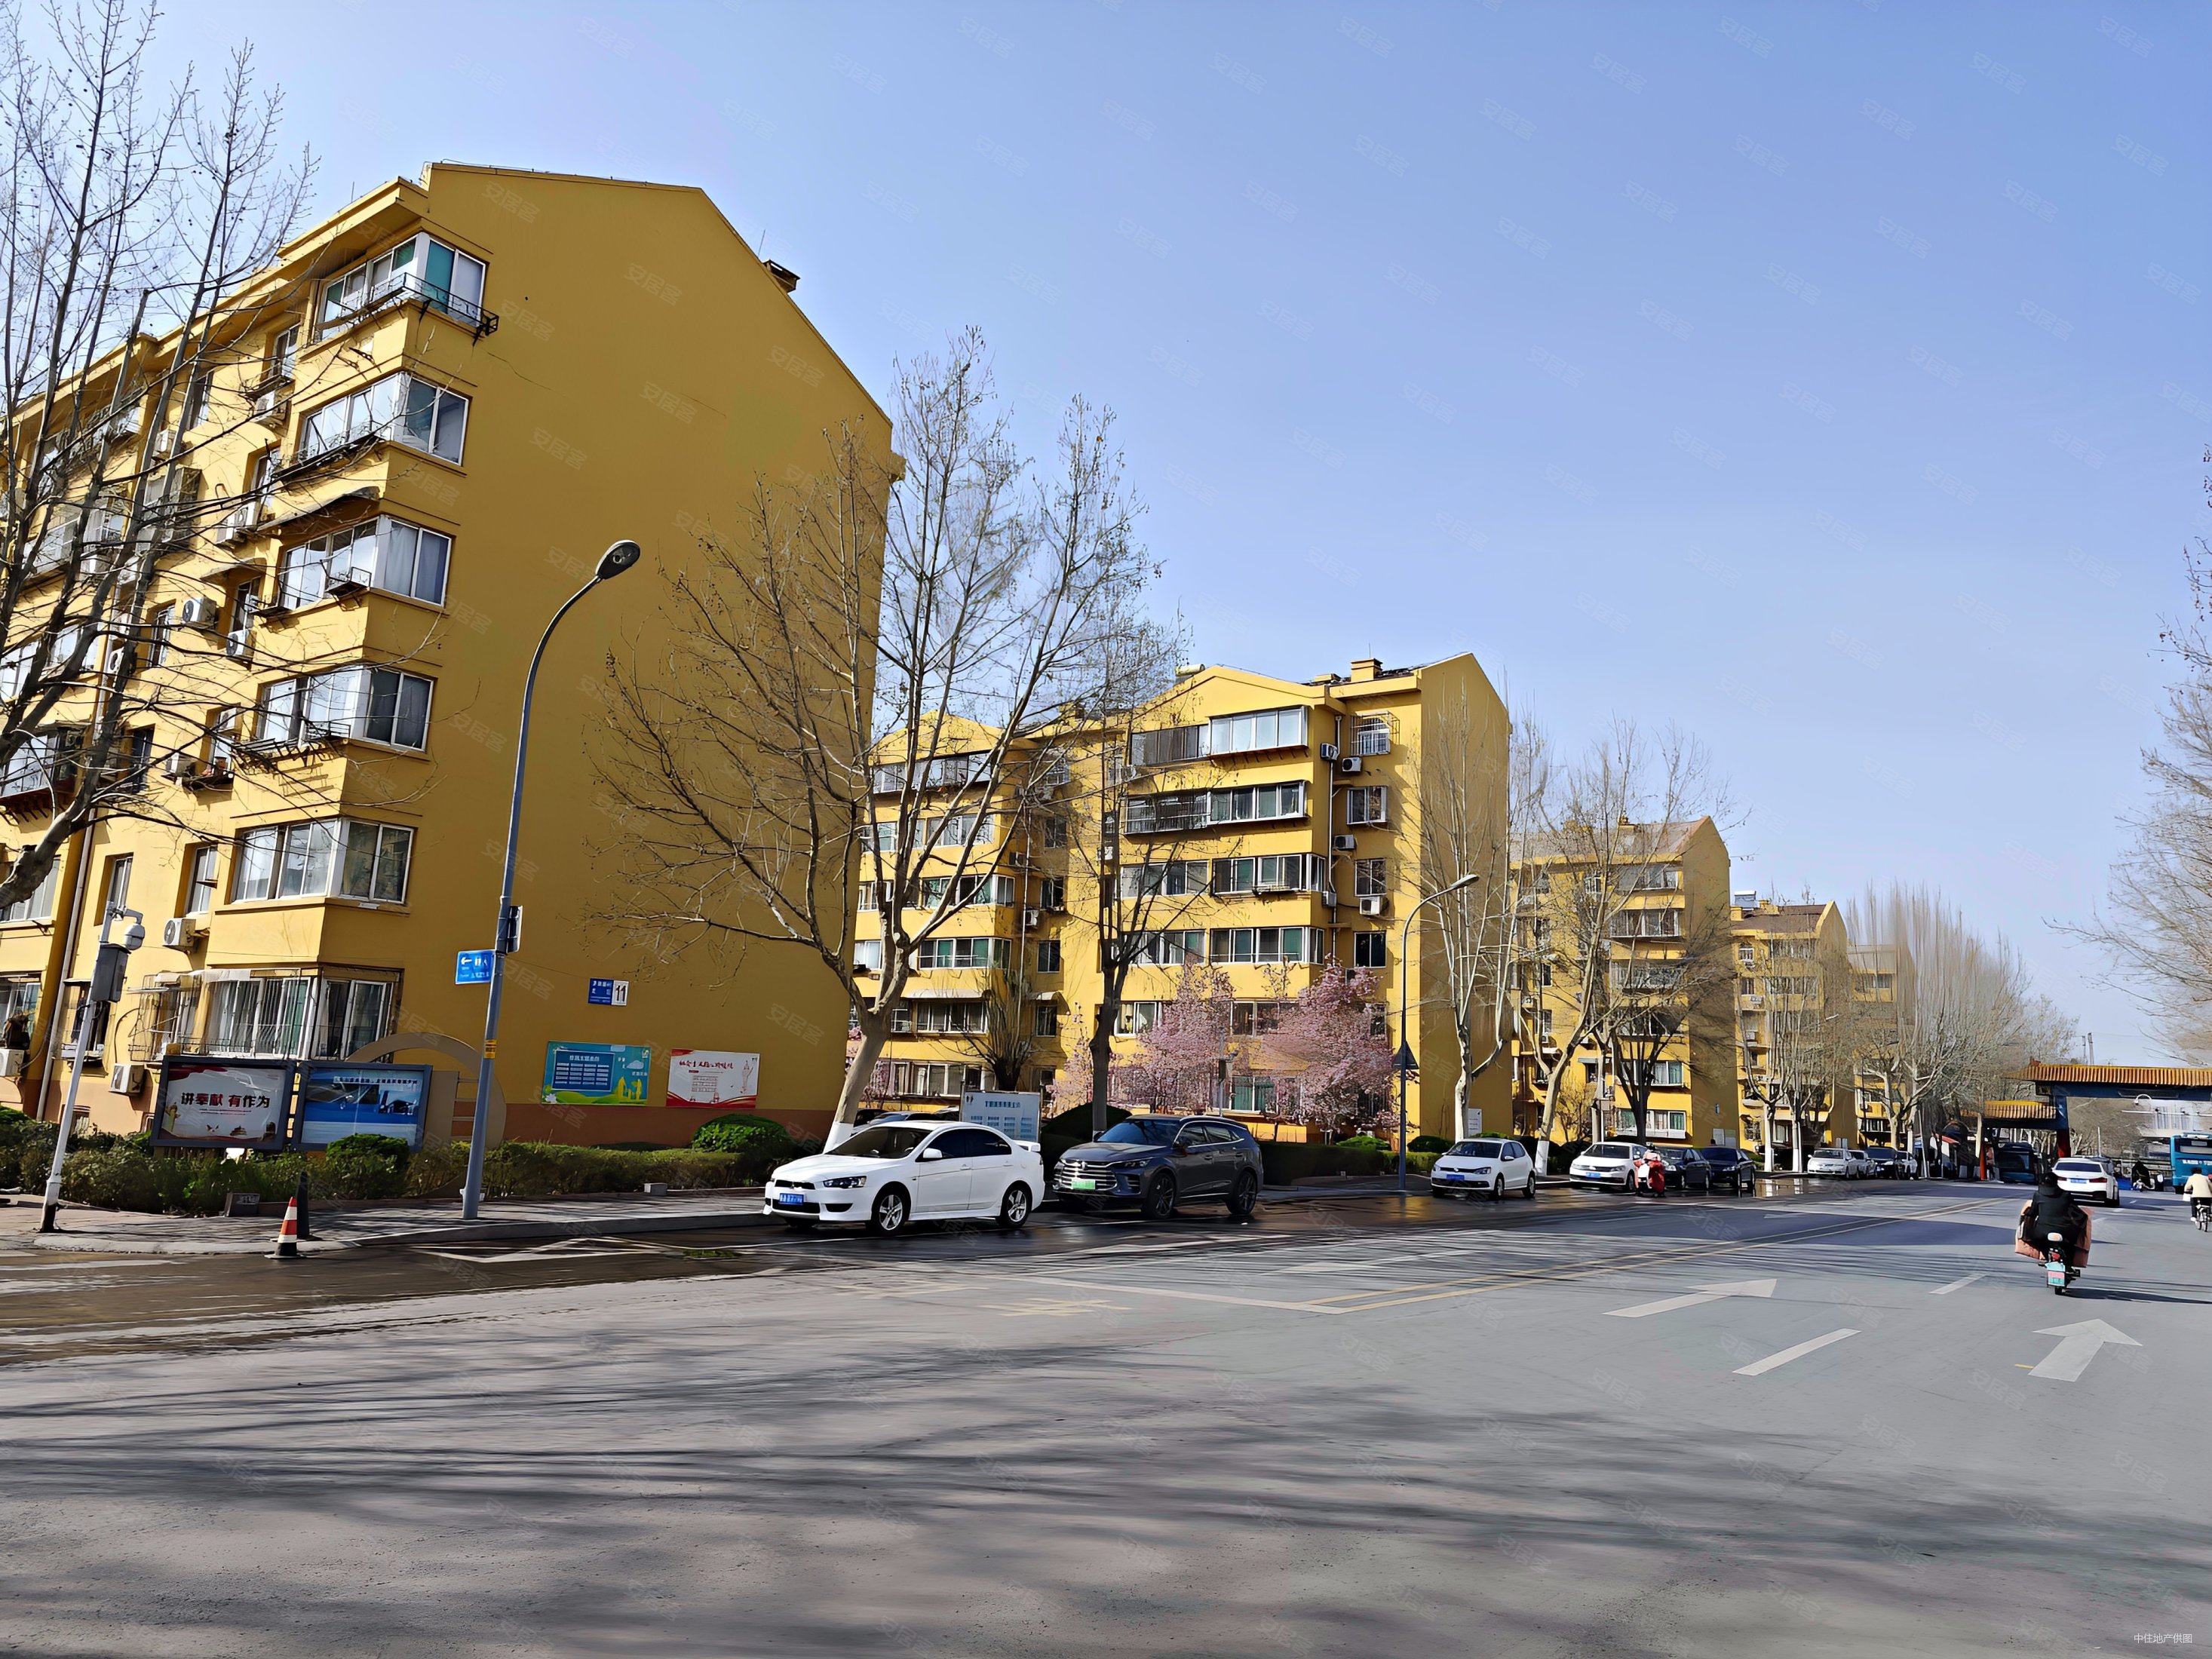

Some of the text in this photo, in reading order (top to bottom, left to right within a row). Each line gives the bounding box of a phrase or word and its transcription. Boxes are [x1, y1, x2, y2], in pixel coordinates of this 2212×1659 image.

[615, 985, 627, 1002] 11
[181, 1092, 271, 1109] 讲奉献 有作为
